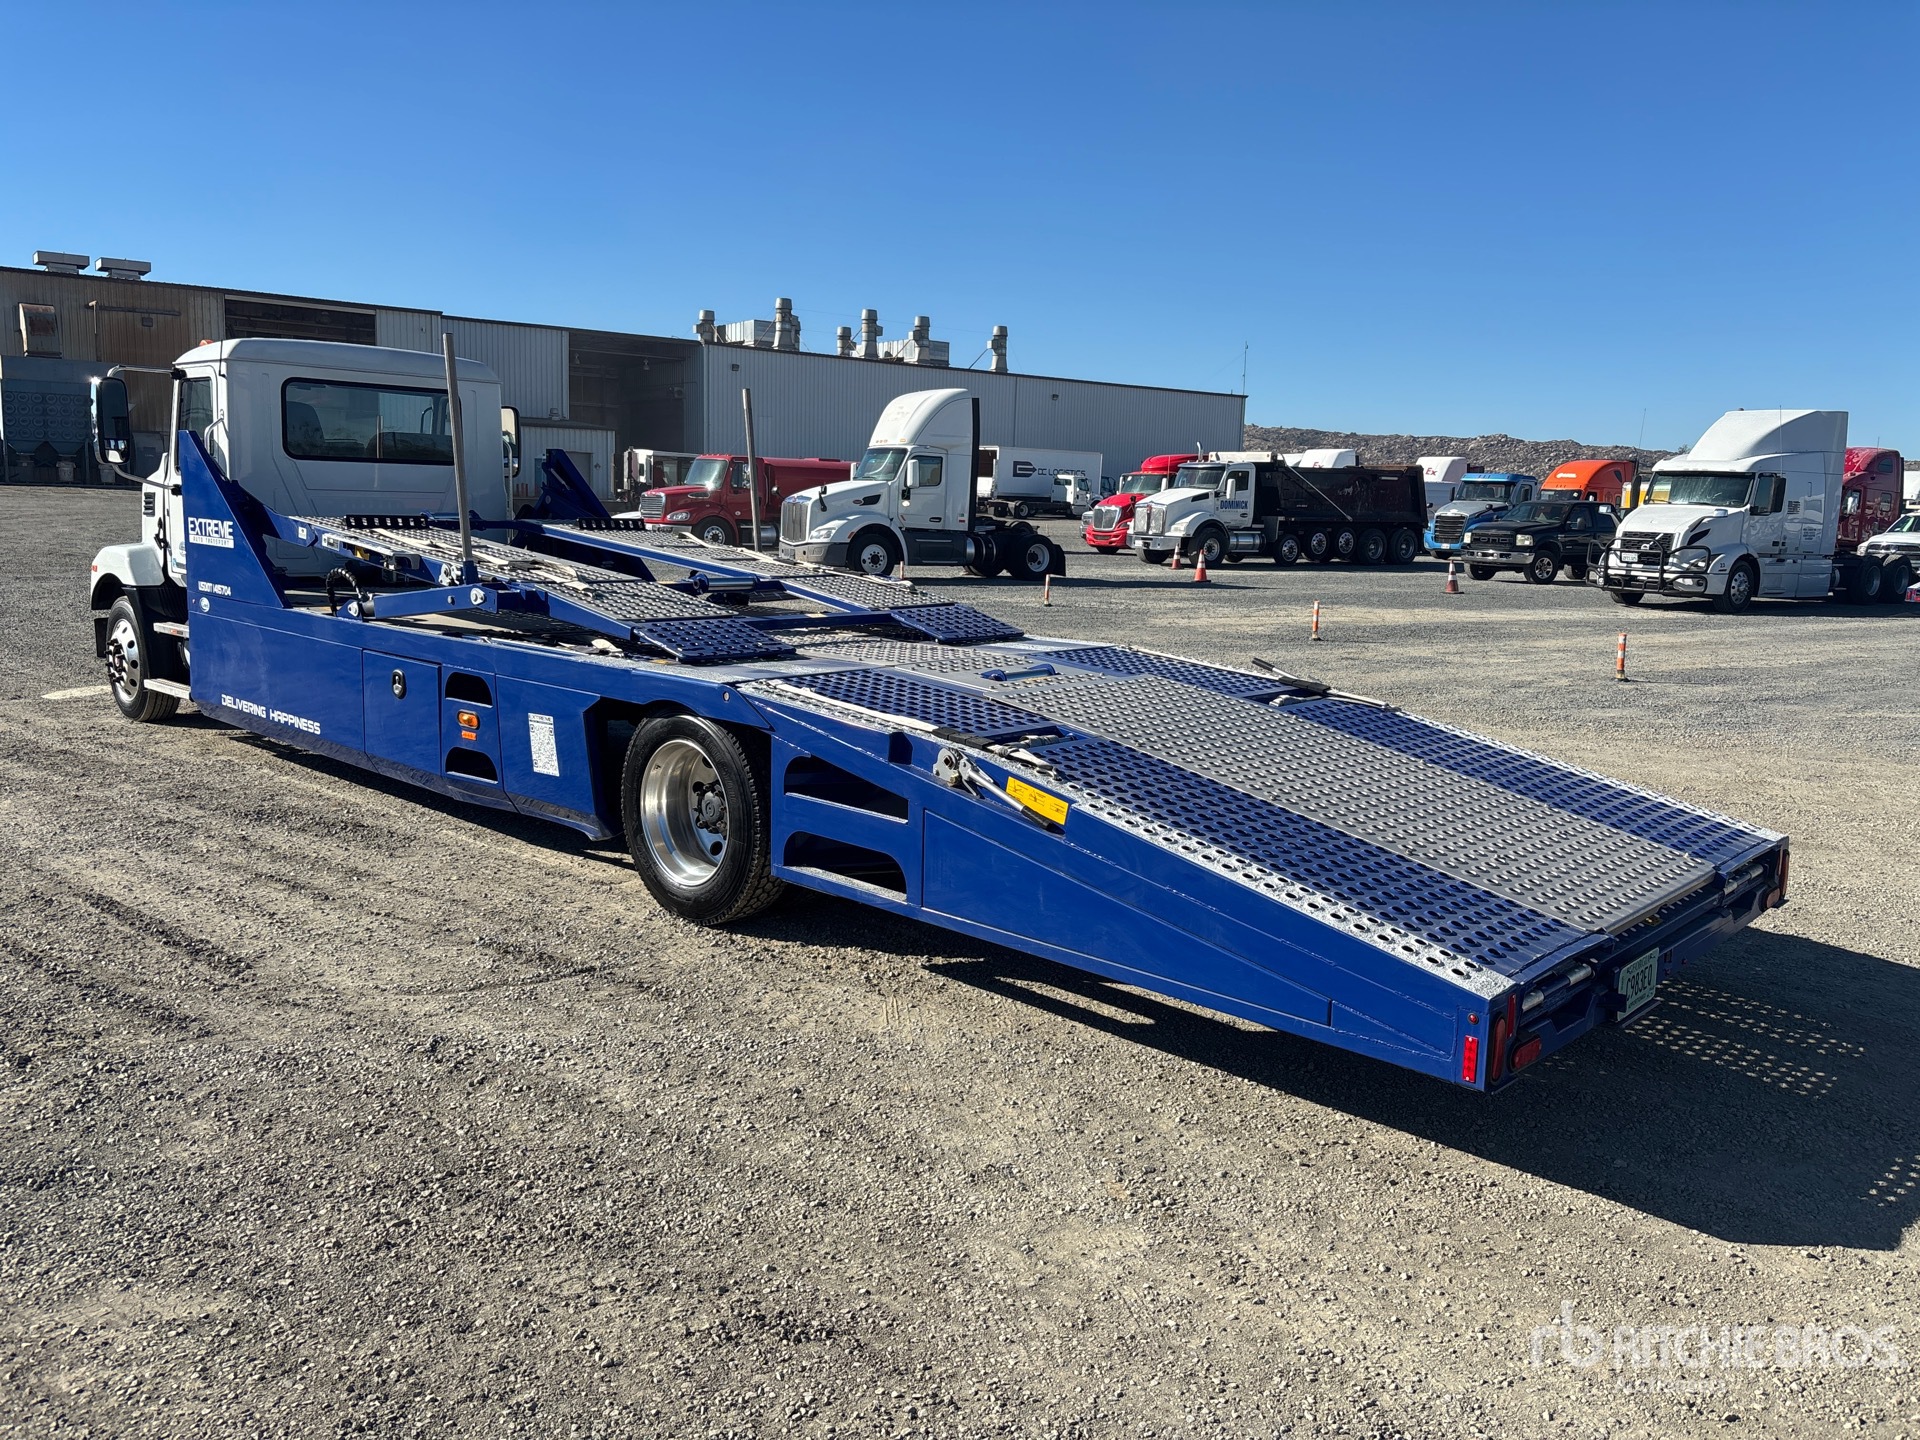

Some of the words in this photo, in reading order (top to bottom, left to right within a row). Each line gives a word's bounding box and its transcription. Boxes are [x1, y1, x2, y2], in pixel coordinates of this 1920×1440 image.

[1220, 500, 1249, 510] DOMINICK
[188, 517, 234, 540] EXTREME
[221, 694, 267, 718] DELIVERING
[269, 709, 321, 735] HAPPINESS
